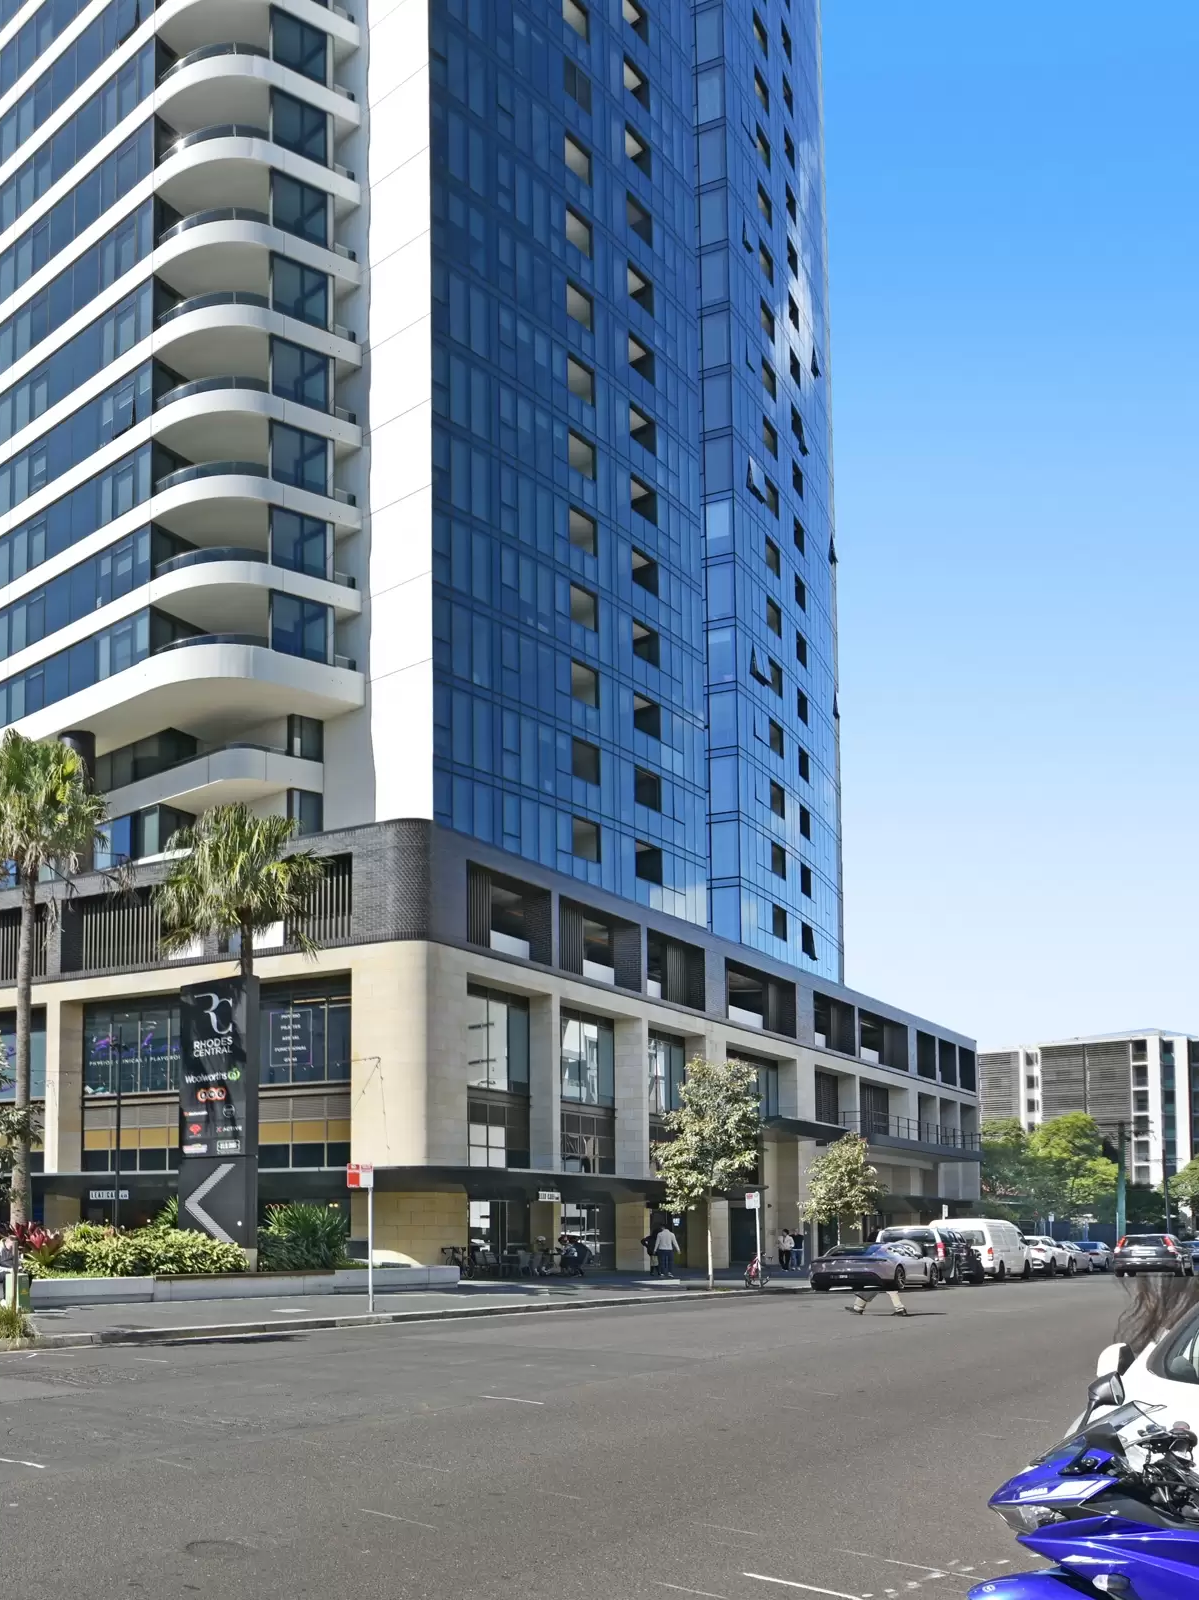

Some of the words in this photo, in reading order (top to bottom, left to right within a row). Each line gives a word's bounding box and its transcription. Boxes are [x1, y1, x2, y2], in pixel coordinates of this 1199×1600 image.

[193, 1036, 233, 1050] RHODES
[193, 1045, 233, 1057] CENTRAL
[184, 1071, 227, 1084] Woolworths
